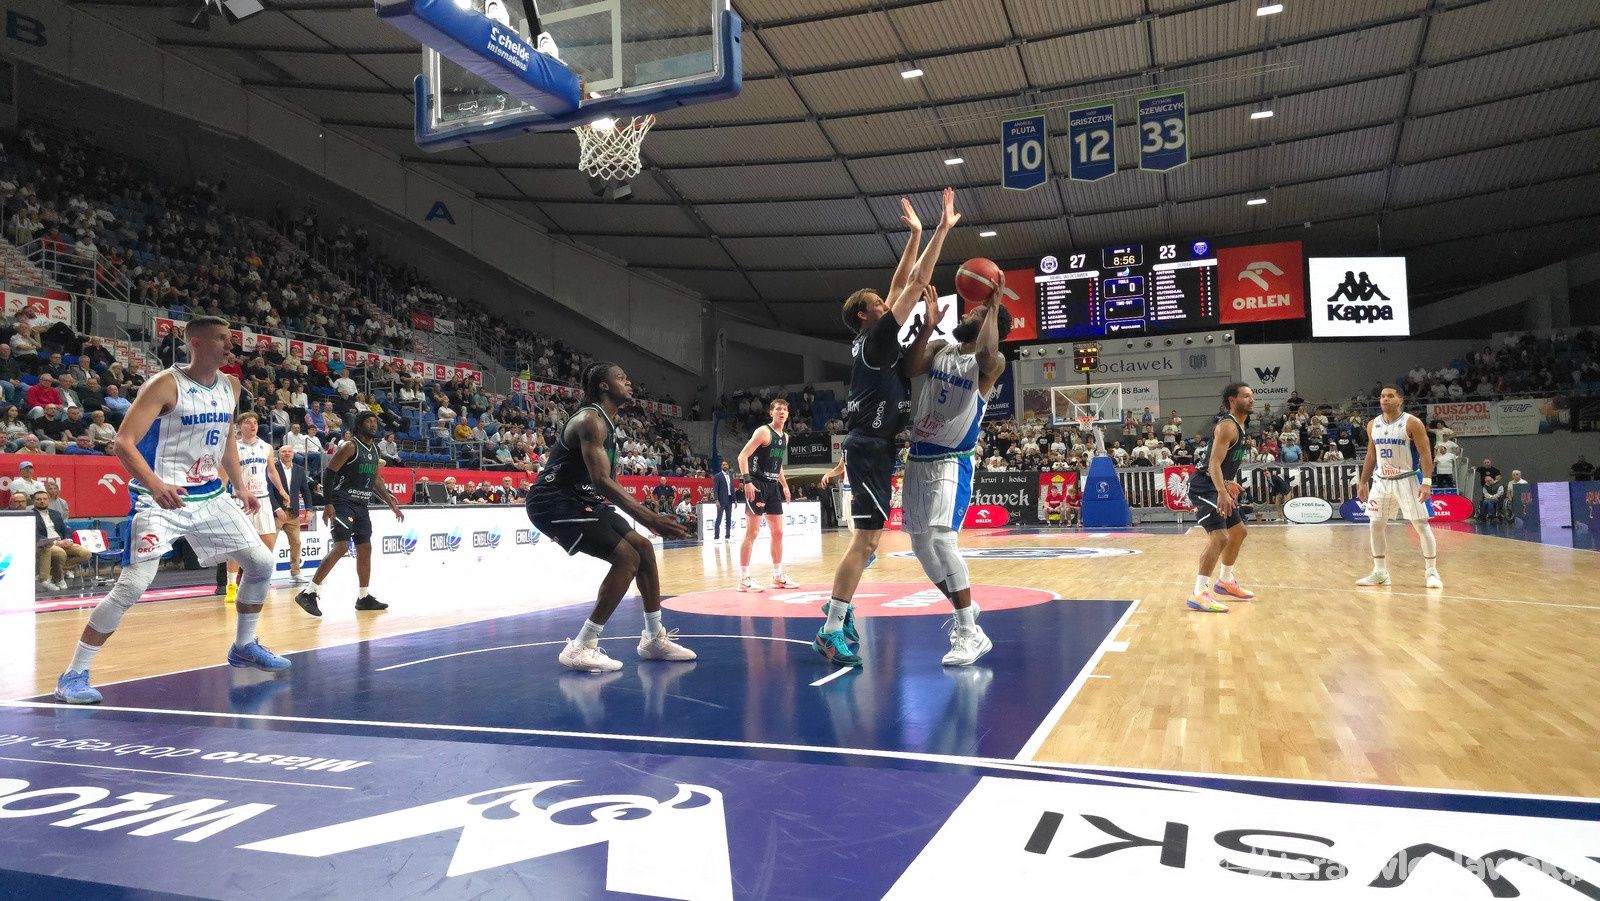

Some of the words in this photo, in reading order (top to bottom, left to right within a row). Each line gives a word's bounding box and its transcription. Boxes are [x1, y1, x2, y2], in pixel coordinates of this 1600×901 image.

[6, 9, 47, 47] B
[1139, 102, 1184, 115] SZEWCZYK
[1070, 114, 1113, 127] GRISZCZUK
[1011, 126, 1036, 135] PLUTA
[1142, 118, 1185, 152] 33
[1074, 130, 1110, 163] 12
[1006, 140, 1043, 172] 10
[425, 201, 456, 225] A
[1160, 244, 1176, 259] 23
[1070, 254, 1086, 269] 27
[1113, 256, 1135, 266] 8:56
[1111, 284, 1117, 294] 1
[1129, 282, 1136, 292] 0
[1232, 294, 1290, 310] ORLEN
[1327, 304, 1393, 323] Kappa
[1099, 357, 1173, 373] ocławek
[938, 389, 948, 404] 5
[987, 403, 1010, 411] OCŁAWEK
[1433, 404, 1490, 415] DUSZPOL
[181, 412, 231, 426] WŁOCŁAW
[205, 430, 220, 446] 16
[1380, 449, 1392, 458] 20
[358, 463, 377, 474] DONA
[365, 478, 370, 489] 2
[384, 483, 407, 494] RLEN
[970, 489, 1030, 506] cławek
[383, 538, 401, 552] ENBL
[431, 535, 447, 550] ENBL
[474, 533, 489, 547] ENBL
[517, 531, 530, 544] ENBL
[31, 737, 201, 760] dobrego
[201, 751, 374, 773] Miasto
[0, 778, 277, 843] WŁO
[1023, 811, 1600, 899] WSKI
